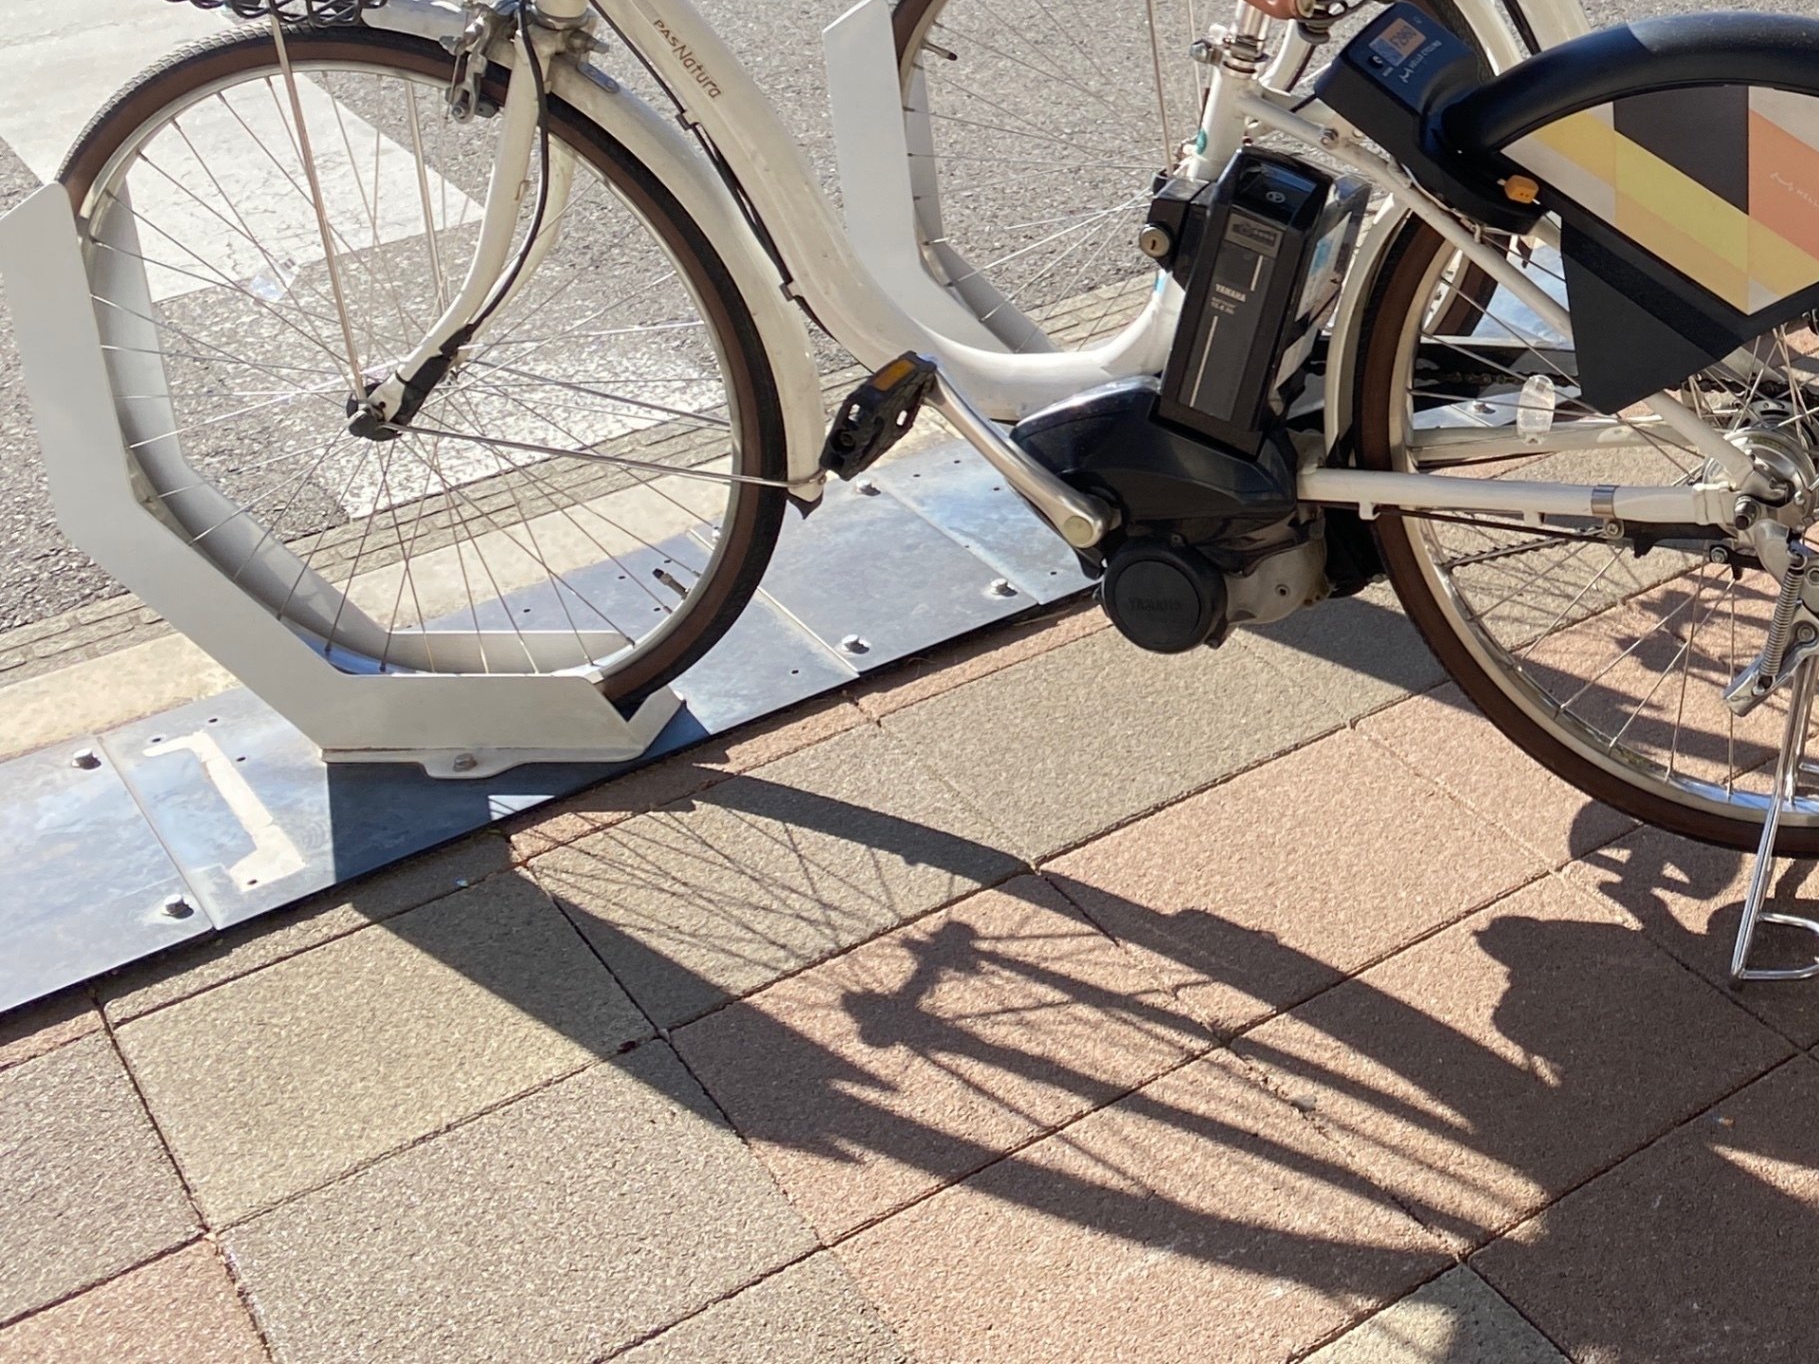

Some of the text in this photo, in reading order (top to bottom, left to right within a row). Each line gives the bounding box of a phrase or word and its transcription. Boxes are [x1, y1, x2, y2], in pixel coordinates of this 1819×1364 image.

[654, 19, 722, 99] PAS Natura
[1215, 283, 1246, 302] YAMAHA
[142, 729, 306, 893] 1
